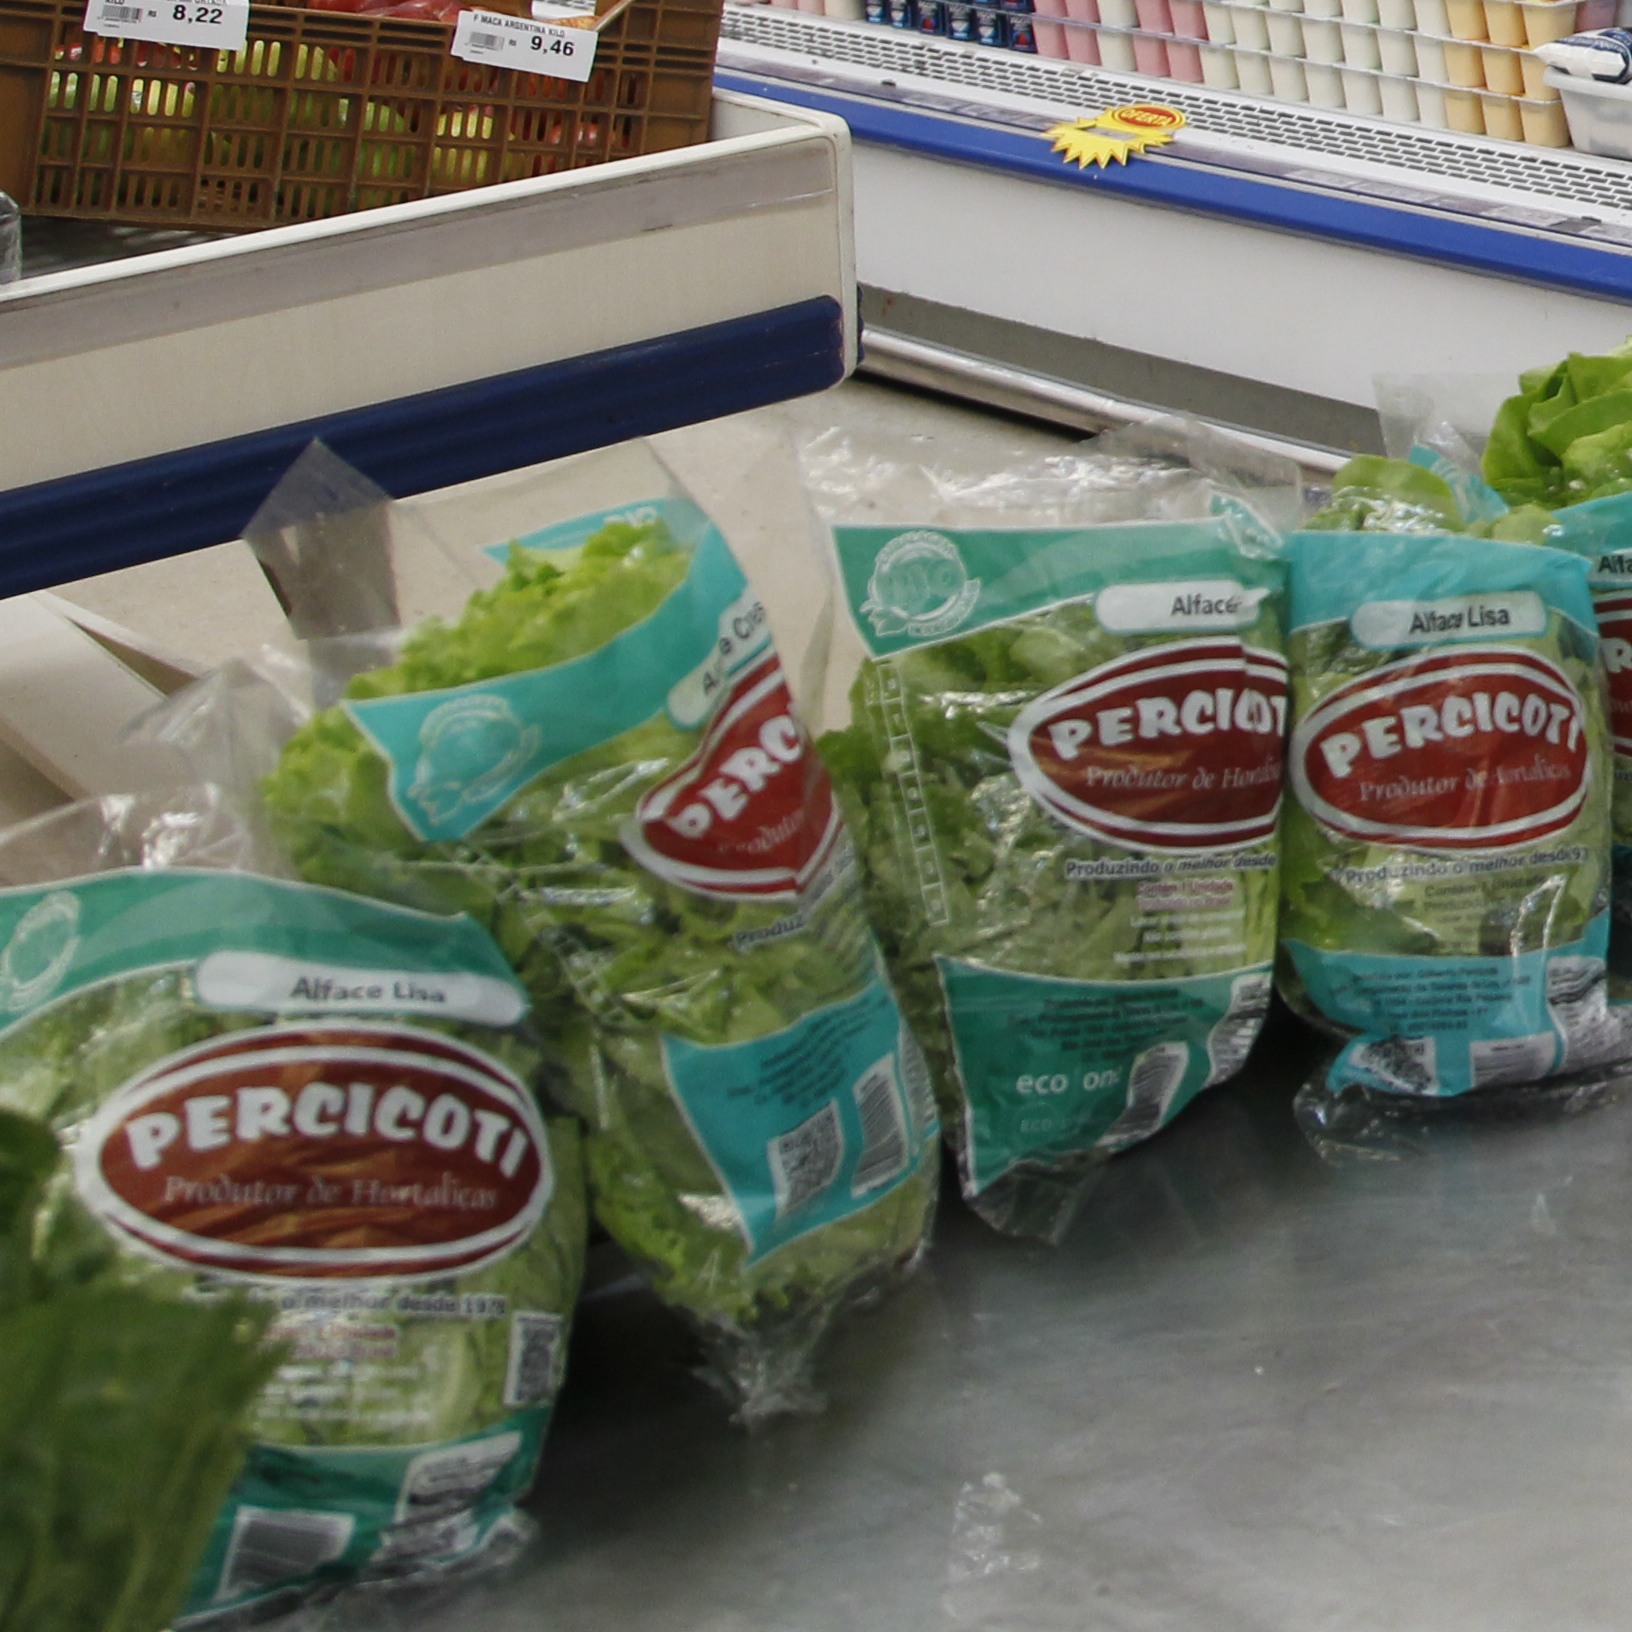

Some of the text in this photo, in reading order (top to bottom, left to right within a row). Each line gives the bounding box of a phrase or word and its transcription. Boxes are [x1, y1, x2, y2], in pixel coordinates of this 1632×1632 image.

[173, 4, 224, 24] 8,22
[481, 14, 503, 27] MACA
[504, 19, 547, 35] ARGENTINA
[548, 26, 566, 38] KILO
[530, 35, 576, 57] 9,46
[1121, 108, 1173, 126] OFERTA
[1467, 605, 1511, 628] Lisa
[1319, 690, 1581, 779] PERCICOTI
[1086, 765, 1215, 789] Produtor de
[1358, 775, 1461, 802] Produtor
[1066, 859, 1160, 877] Produzindo
[1177, 856, 1229, 871] melhor
[1234, 853, 1276, 868] desde
[1345, 861, 1448, 883] Produzindo
[1469, 854, 1526, 873] melhor
[290, 976, 447, 1004] Alface Lisa
[1015, 1071, 1068, 1096] eco
[125, 1081, 529, 1179] PERCICOTI
[163, 1174, 298, 1208] Produtor
[305, 1174, 343, 1207] de
[303, 1294, 390, 1311] melhor
[398, 1295, 459, 1313] desde
